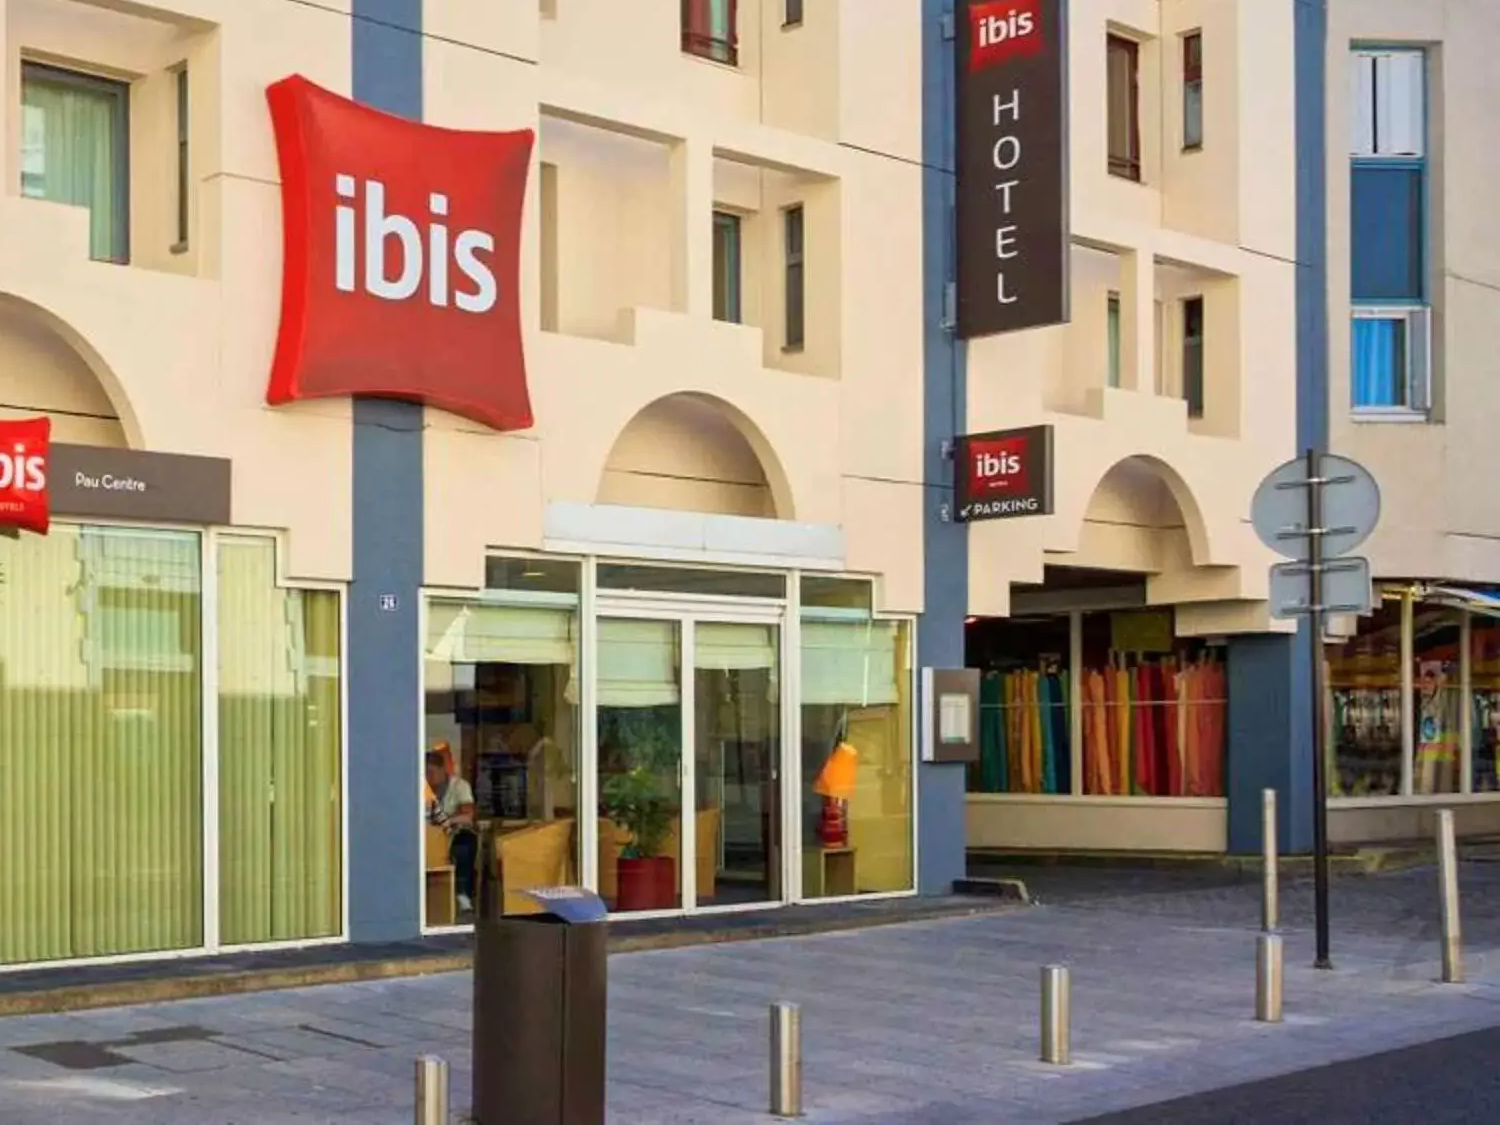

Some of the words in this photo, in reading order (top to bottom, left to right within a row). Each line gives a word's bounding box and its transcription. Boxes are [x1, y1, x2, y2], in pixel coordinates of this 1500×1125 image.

[978, 8, 1034, 48] ibis
[992, 88, 1021, 304] HOTEL
[335, 172, 497, 314] ibis
[976, 450, 1021, 478] ibis
[75, 471, 99, 488] Pau
[101, 474, 147, 492] Centre
[973, 497, 1038, 516] PARKING
